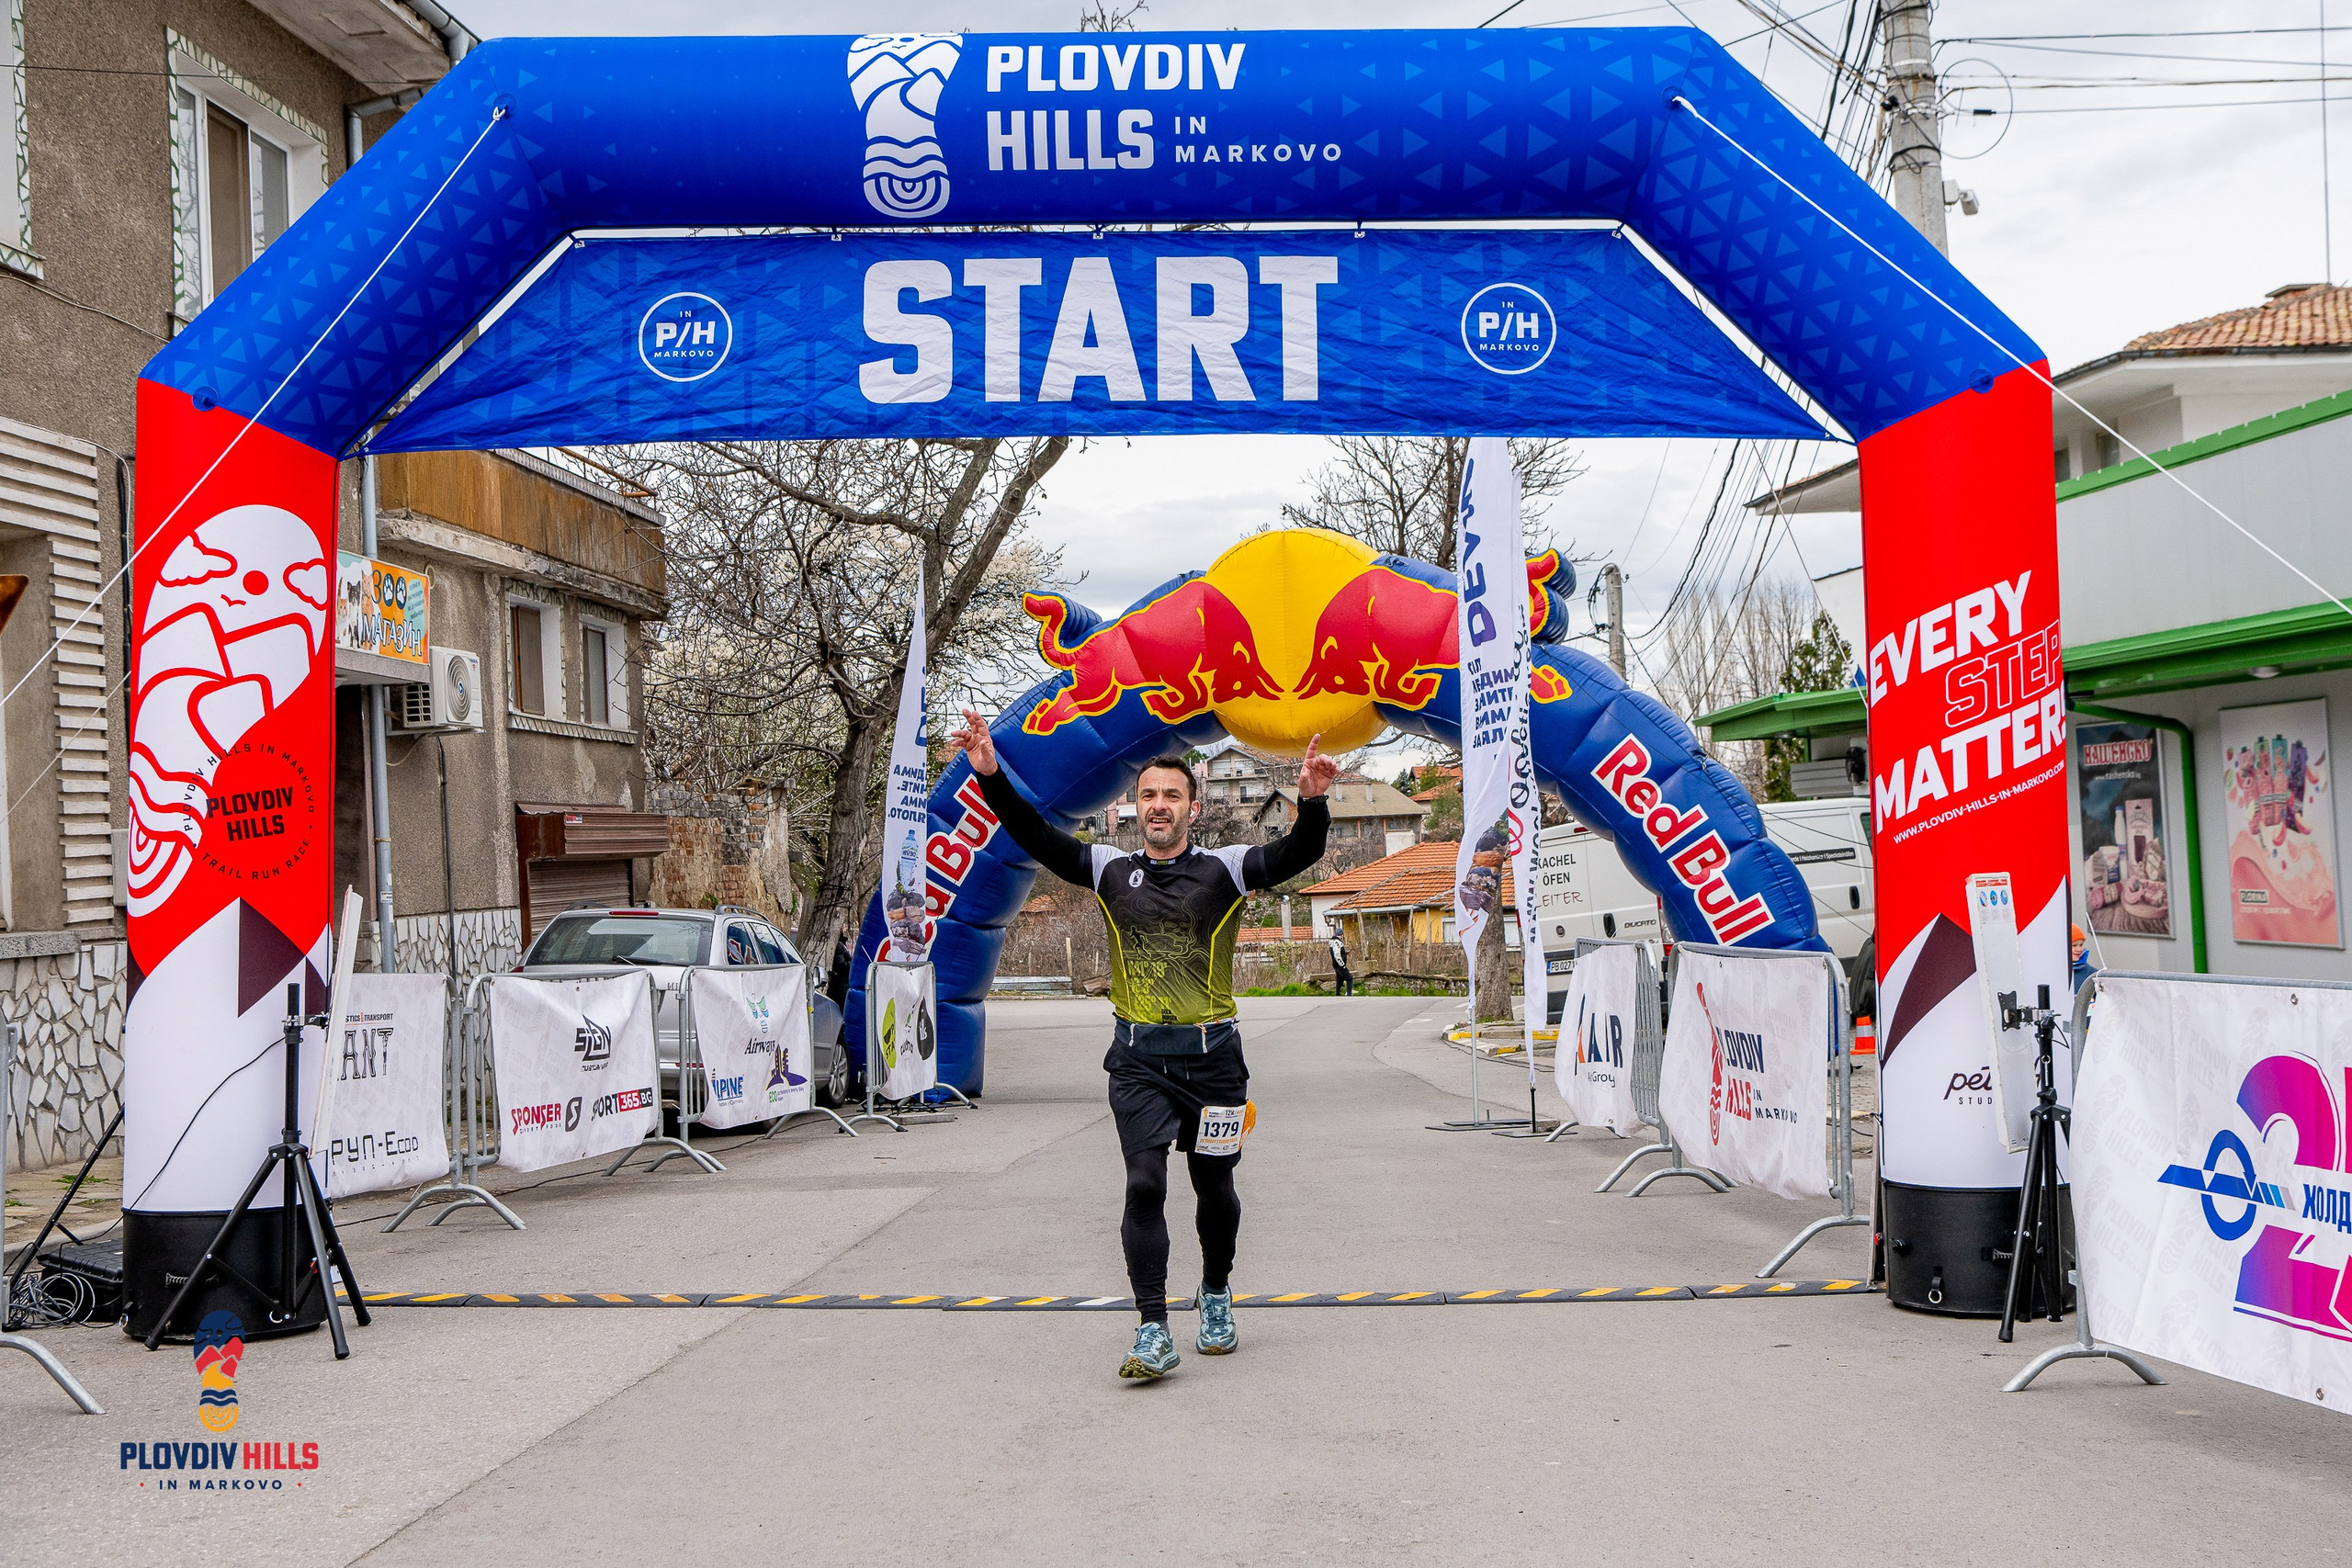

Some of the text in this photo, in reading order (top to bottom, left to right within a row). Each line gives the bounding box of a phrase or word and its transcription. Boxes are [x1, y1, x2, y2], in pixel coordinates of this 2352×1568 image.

[987, 42, 1246, 93] PLOVDIV
[988, 108, 1155, 171] HILLS
[1174, 116, 1206, 135] IN
[1175, 143, 1342, 163] MARKOVO
[656, 321, 716, 347] P/H
[858, 255, 1339, 404] START
[1478, 312, 1539, 341] P/H
[654, 350, 714, 358] MARKOVO
[362, 612, 423, 657] МАГАЗИН
[1871, 570, 2032, 709] EVERY
[1945, 618, 2063, 728] STEP
[1875, 679, 2066, 835] MATTER
[2083, 738, 2153, 766] НАШЕНСКО
[183, 743, 314, 832] PLOVDIV HILLS IN MARKOVO
[206, 786, 293, 819] PLOVDIV
[1894, 759, 2064, 844] WWW.PLOVDIV-HILLS-IN-MARKOVO.COM
[226, 814, 285, 842] HILLS
[1593, 736, 1772, 945] Red Bull
[202, 838, 310, 880] TRAIL RUN RACE
[1543, 872, 1571, 887] ÖFEN
[1624, 919, 1657, 929] DUCATO
[364, 1013, 394, 1022] TRANSPORT
[340, 1027, 394, 1081] ANT
[744, 1038, 775, 1056] Airways
[1753, 1089, 1762, 1101] IN
[511, 1103, 562, 1136] SPONSER
[1204, 1121, 1239, 1138] 1379
[2302, 1183, 2352, 1235] ХОЛД
